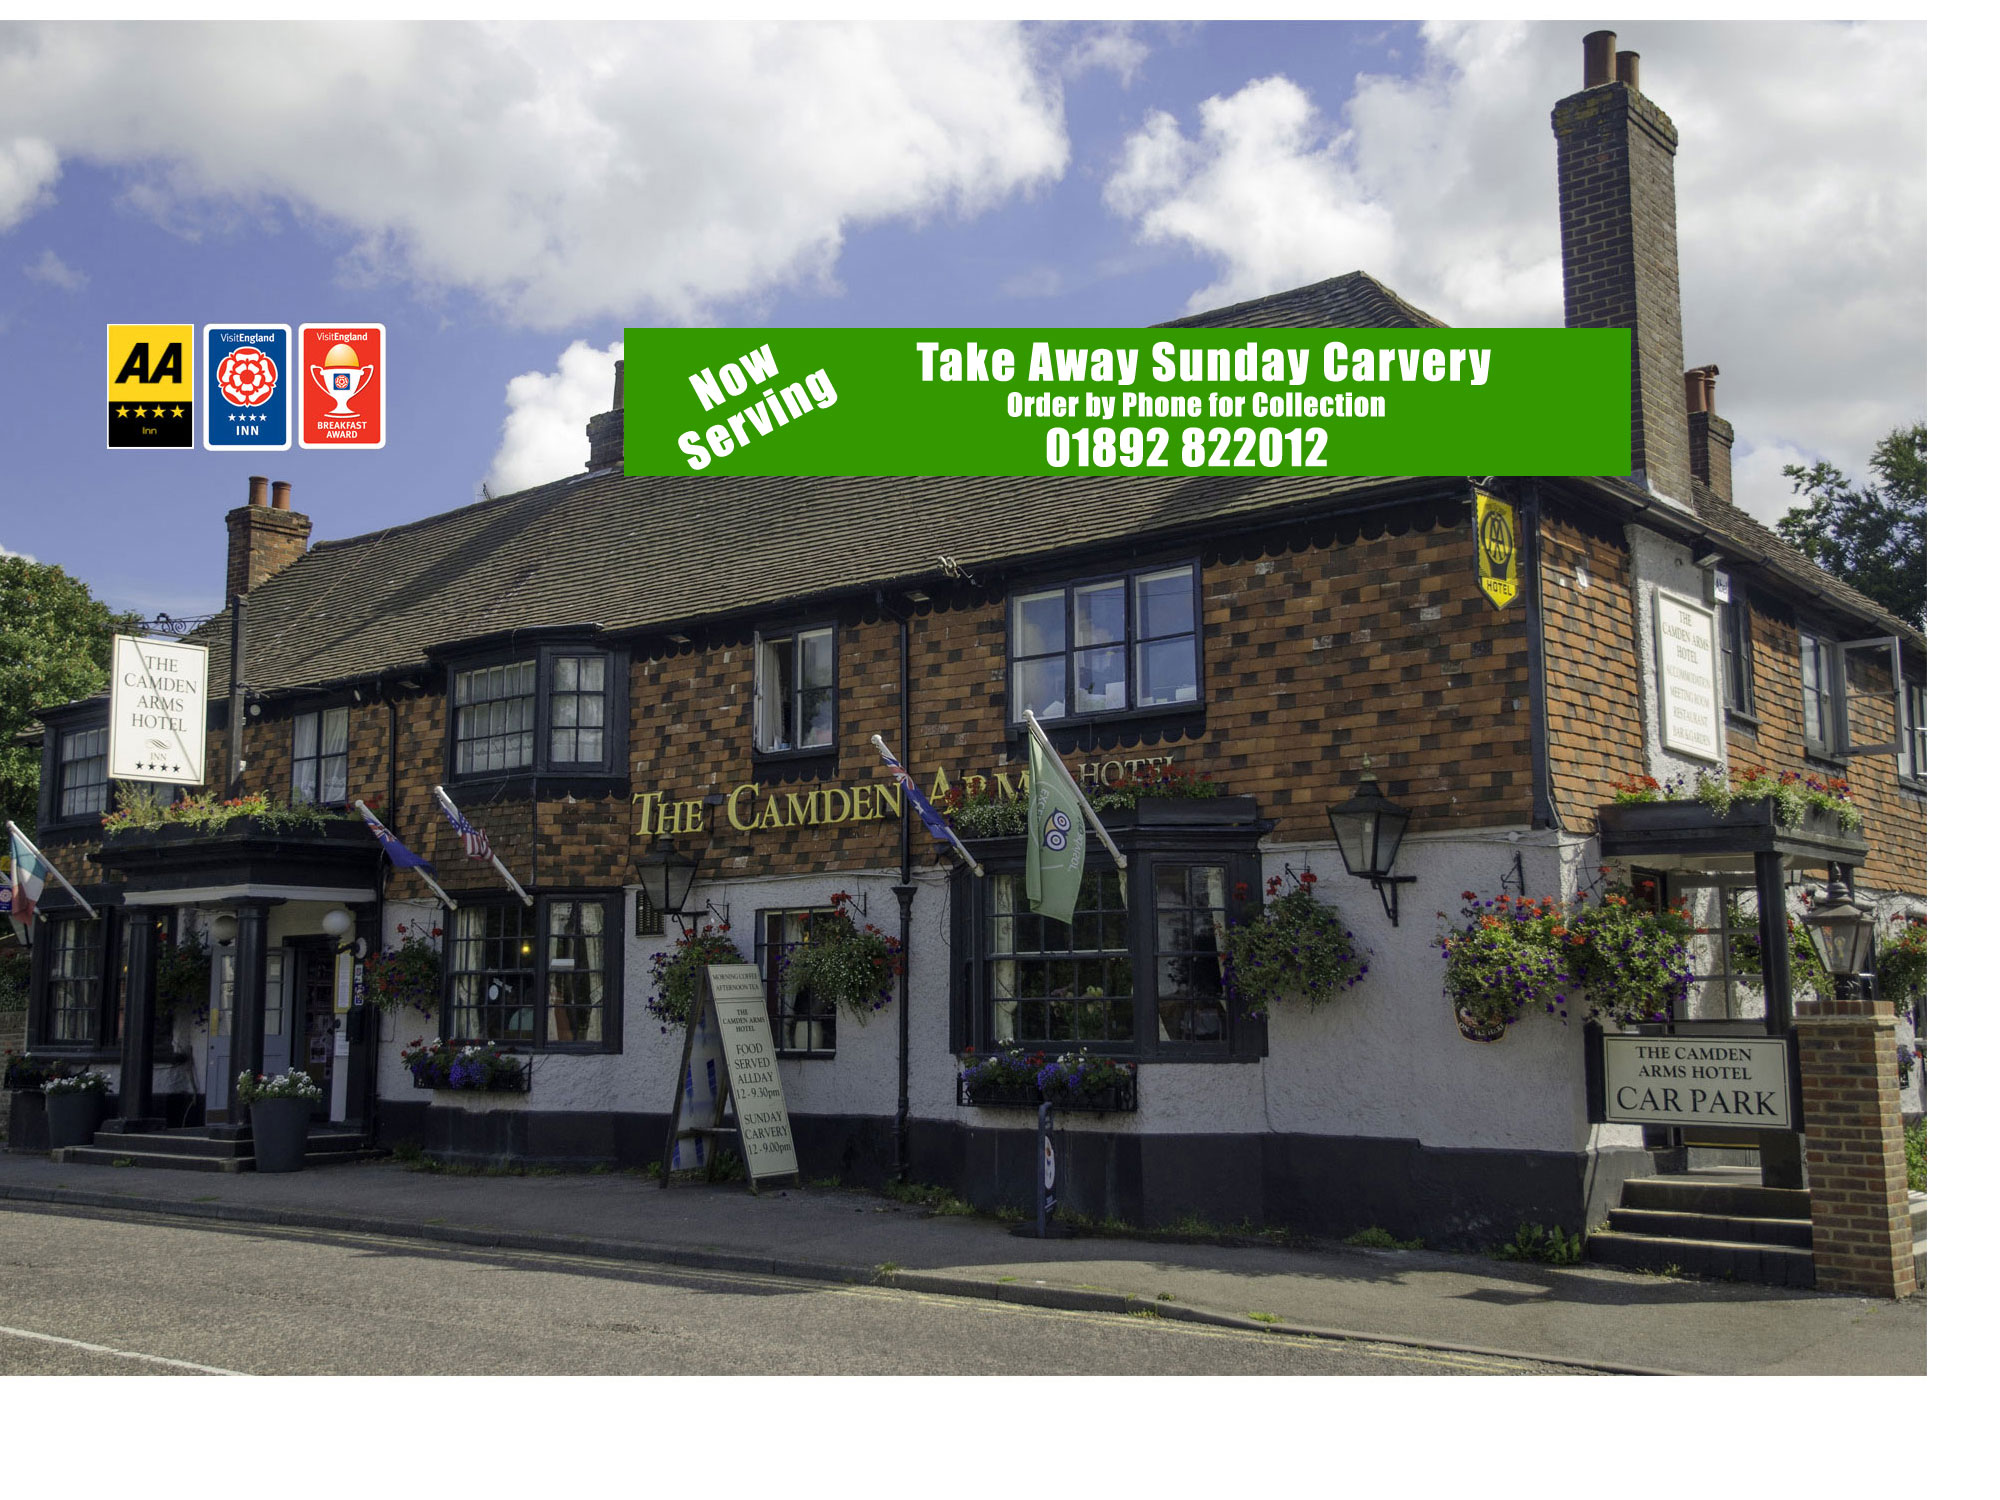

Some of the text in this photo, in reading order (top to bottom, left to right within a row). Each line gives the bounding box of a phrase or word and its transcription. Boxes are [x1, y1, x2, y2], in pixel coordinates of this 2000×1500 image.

[1486, 579, 1512, 596] HOTEL
[1679, 610, 1692, 627] THE
[1662, 622, 1709, 650] CAMDEN ARMS
[1677, 645, 1698, 665] HOTEL
[145, 656, 178, 673] THE
[124, 673, 197, 694] CAMDEN
[137, 695, 184, 712] ARMS
[132, 713, 187, 732] HOTEL
[150, 752, 167, 761] INN
[632, 791, 704, 836] THE
[727, 783, 902, 832] CAMDEN
[930, 766, 1030, 815] ARM
[723, 1017, 749, 1025] CAMDEN
[736, 1043, 763, 1055] FOOD
[1635, 1046, 1752, 1061] THE CAMDEN
[734, 1057, 771, 1070] SERVED
[738, 1072, 774, 1084] ALLDAY
[1638, 1065, 1752, 1080] ARMS HOTEL
[1616, 1086, 1778, 1116] CAR PARK
[744, 1111, 782, 1124] SUNDAY
[745, 1125, 788, 1140] CARVERY
